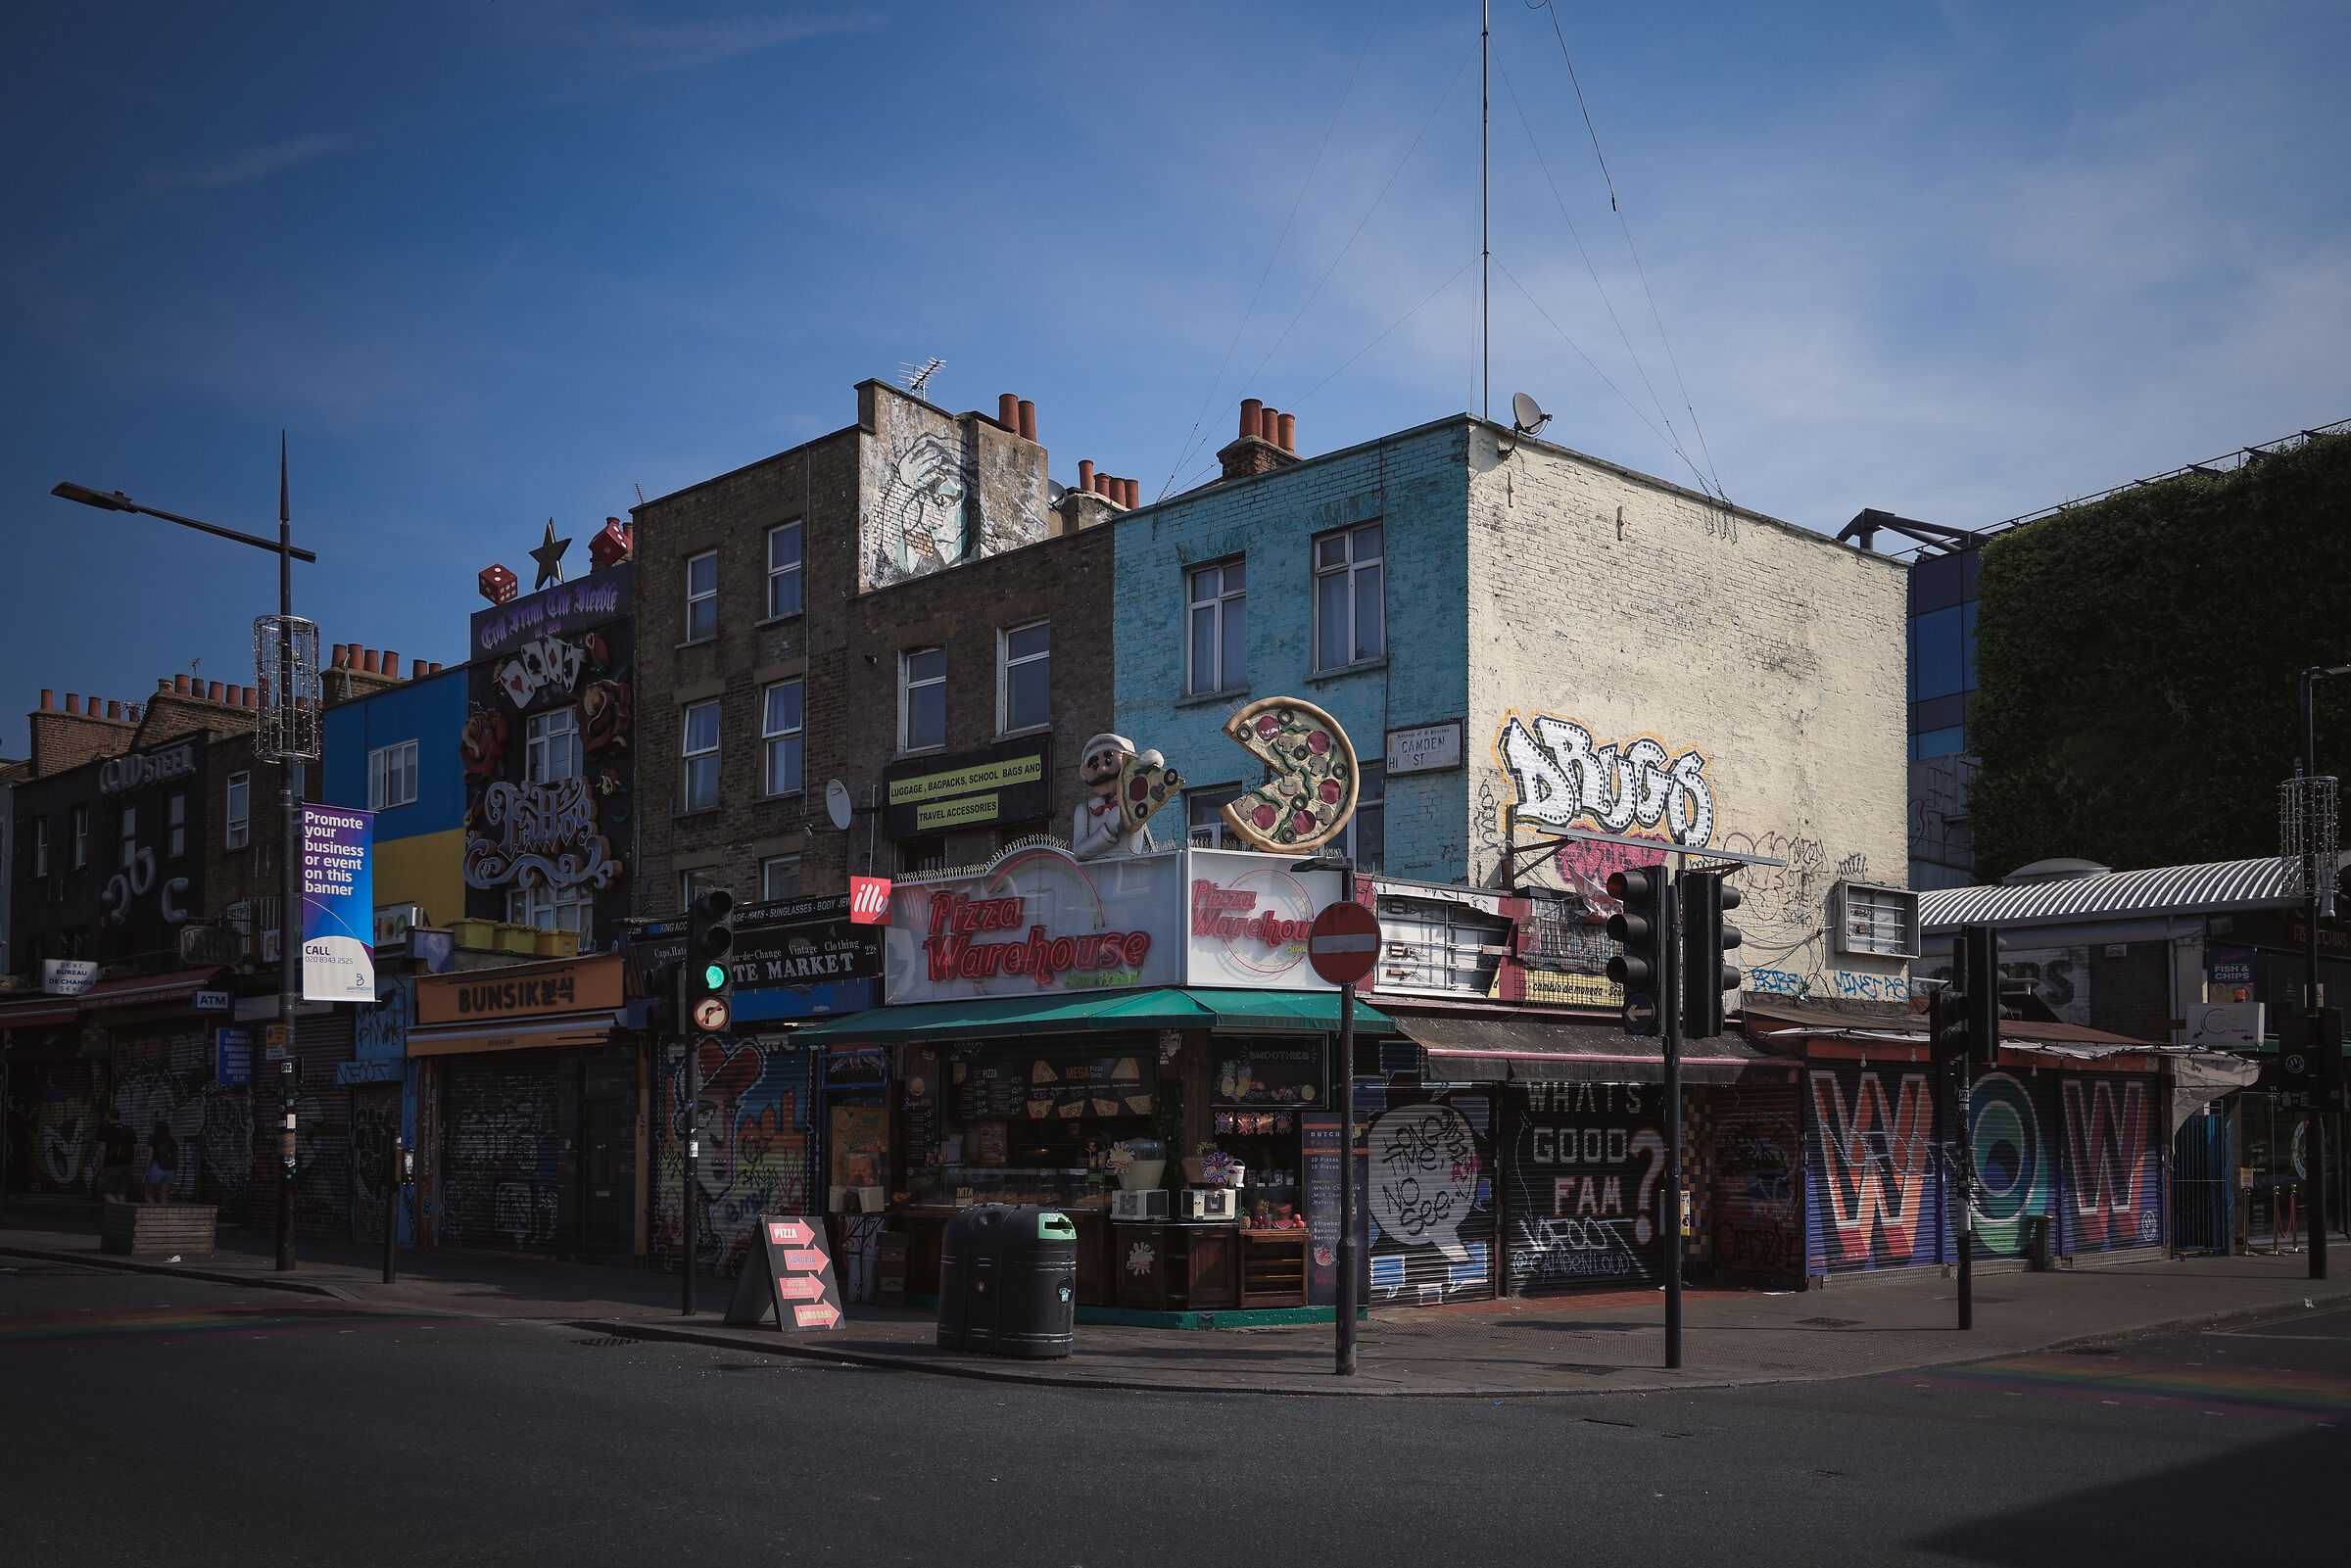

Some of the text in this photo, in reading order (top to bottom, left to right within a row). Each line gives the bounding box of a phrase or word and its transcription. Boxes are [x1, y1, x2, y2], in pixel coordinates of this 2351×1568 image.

[1402, 736, 1445, 753] CAMDEN
[969, 771, 999, 784] SCHOOL
[1002, 765, 1023, 778] BAGS
[1024, 762, 1040, 775] AND
[1501, 713, 1716, 848] DRUGS
[305, 811, 363, 830] Promote
[919, 801, 997, 823] TRAVEL ACCESSORIES
[305, 826, 337, 838] your
[305, 839, 364, 857] business
[305, 855, 362, 871] or event
[305, 869, 353, 882] on this
[305, 879, 354, 896] banner
[1191, 879, 1258, 910] Pizza
[748, 909, 765, 920] HATS
[770, 902, 813, 918] SUNGLASSES
[817, 900, 836, 911] BODY
[838, 897, 851, 908] JEW
[853, 882, 889, 921] illy
[928, 889, 1027, 934] Pizza
[373, 914, 408, 941] HOP
[1191, 906, 1313, 947] Warehou
[306, 946, 331, 956] CALL
[732, 949, 783, 962] au-de-Change
[788, 944, 818, 956] Vintage
[824, 939, 860, 953] Clothing
[923, 924, 1152, 985] Warehouse
[733, 952, 854, 983] TE MARKET
[1533, 981, 1561, 993] cambio
[1562, 982, 1573, 993] de
[1574, 985, 1604, 996] moneda
[200, 995, 226, 1006] ATM
[1248, 1051, 1310, 1061] SMOOTHIES
[1066, 1067, 1089, 1079] MEGA
[1526, 1081, 1643, 1114] WHATS
[1533, 1126, 1628, 1164] GOOD
[1382, 1177, 1419, 1214] NO
[1554, 1175, 1623, 1216] FAM
[774, 1228, 798, 1238] PIZZA
